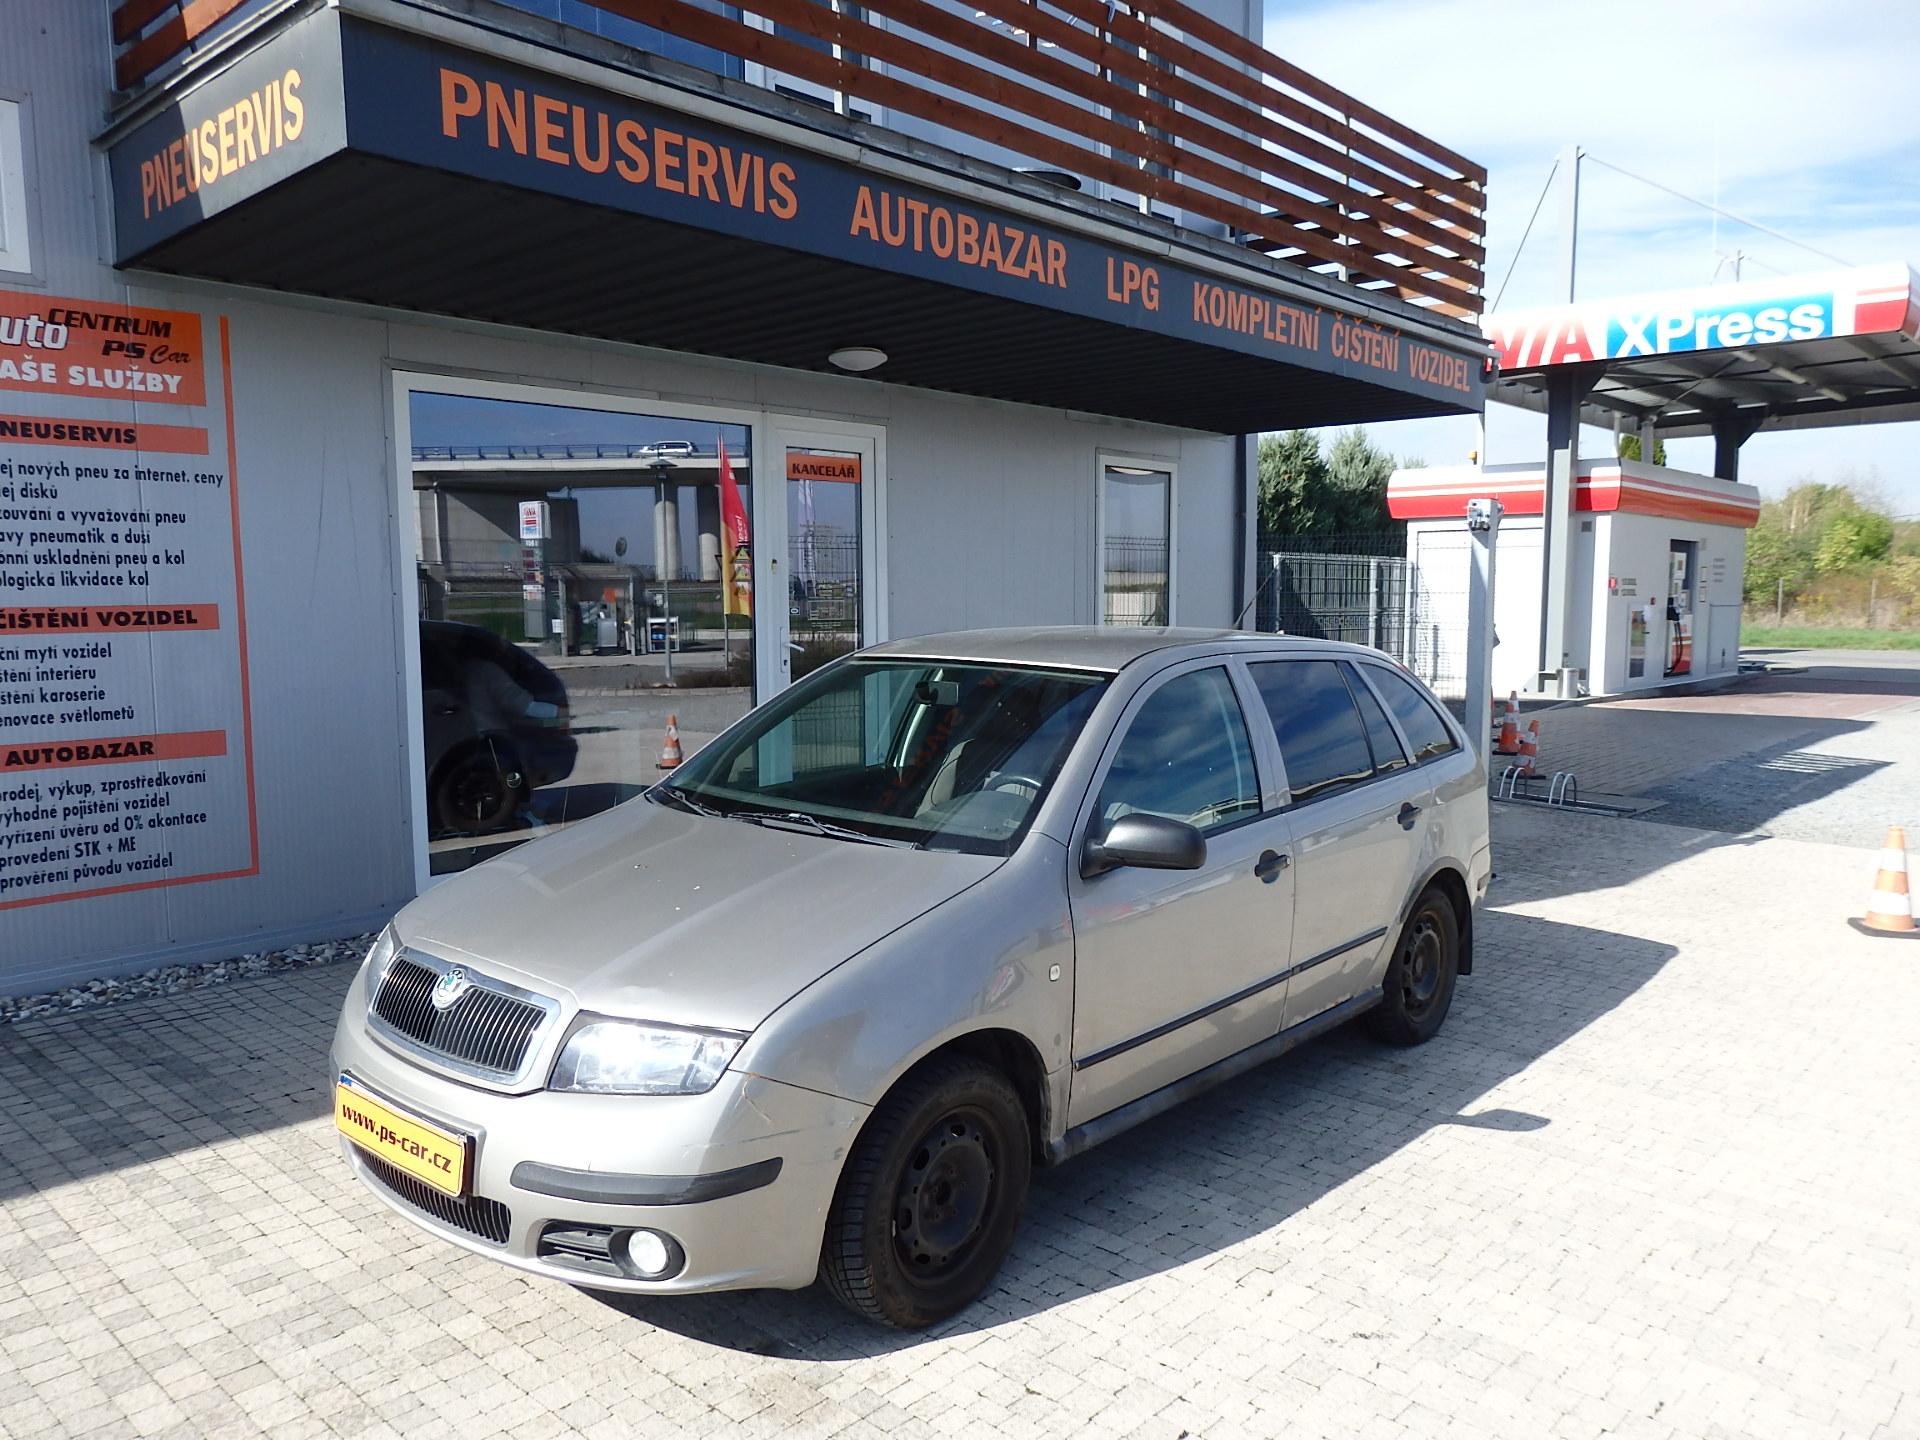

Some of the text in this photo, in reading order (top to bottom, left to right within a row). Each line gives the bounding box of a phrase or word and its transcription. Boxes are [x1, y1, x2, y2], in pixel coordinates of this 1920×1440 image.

[141, 69, 304, 219] PNEUSERVIS
[439, 67, 1471, 392] PNEUSERVIS AUTOBAZAR LPG KOMPLETNÍ ČIŠTĚNÍ VOZIDEL
[48, 308, 172, 338] CENTRUM
[1489, 303, 1824, 371] VIA XPress
[102, 340, 191, 365] PS Car
[68, 364, 182, 394] SLUŽBY
[18, 461, 70, 480] nových
[76, 466, 108, 481] pneu
[114, 468, 129, 480] za
[135, 465, 190, 483] internet.
[194, 472, 223, 487] ceny
[793, 463, 855, 479] KANCELÁŘ
[0, 481, 58, 502] ej disků
[57, 510, 65, 521] a
[71, 507, 151, 526] vyvažování
[155, 511, 186, 527] pneu
[30, 528, 105, 547] pneumatik
[111, 533, 119, 544] a
[124, 528, 151, 544] duší
[33, 549, 110, 565] uskladnění
[115, 554, 147, 568] pneu
[152, 555, 160, 565] a
[165, 550, 185, 565] kol
[61, 570, 123, 586] likvidace
[129, 570, 150, 586] kol
[97, 609, 198, 627] VOZIDEL
[25, 645, 58, 663] mytí
[63, 642, 112, 659] vozidel
[36, 665, 96, 682] interiéru
[40, 685, 106, 703] karoserie
[60, 705, 135, 724] světlometů
[5, 741, 155, 766] AUTOBAZAR
[0, 769, 206, 803] rodej, výkup, zprostředkování
[63, 798, 119, 821] pojištění
[124, 792, 170, 811] vozidel
[60, 823, 99, 839] úvěru
[103, 818, 119, 834] od
[124, 814, 144, 832] 0%
[148, 810, 207, 829] akontace
[0, 845, 70, 873] provedení
[74, 840, 102, 858] STK
[118, 836, 136, 854] ME
[0, 852, 173, 893] prověření původu vozidel
[342, 1104, 452, 1174] www.ps-car.cz
